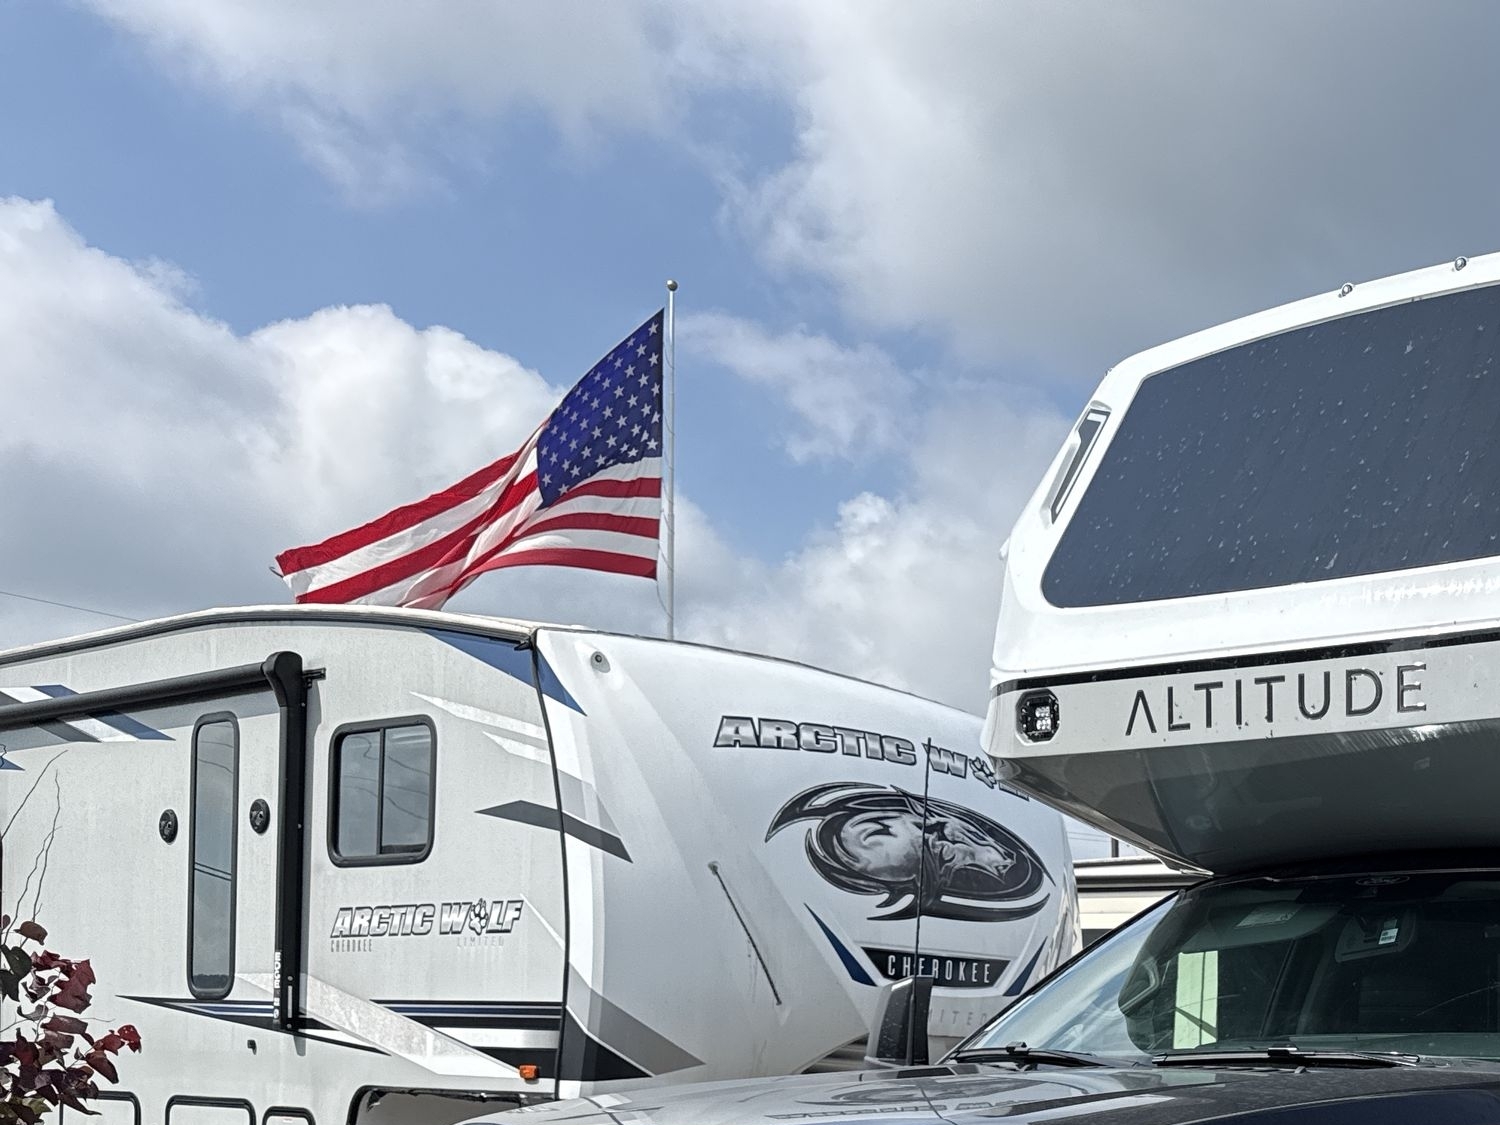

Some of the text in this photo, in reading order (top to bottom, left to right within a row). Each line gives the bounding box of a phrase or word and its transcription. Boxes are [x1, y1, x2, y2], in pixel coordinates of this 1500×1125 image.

[1124, 663, 1428, 737] ALTITUDE
[713, 715, 917, 766] ARCTIC
[330, 903, 436, 938] ARCTIC
[330, 939, 373, 952] CHEROKEE
[456, 936, 505, 947] LIMITED
[887, 954, 991, 984] CHEROKEE
